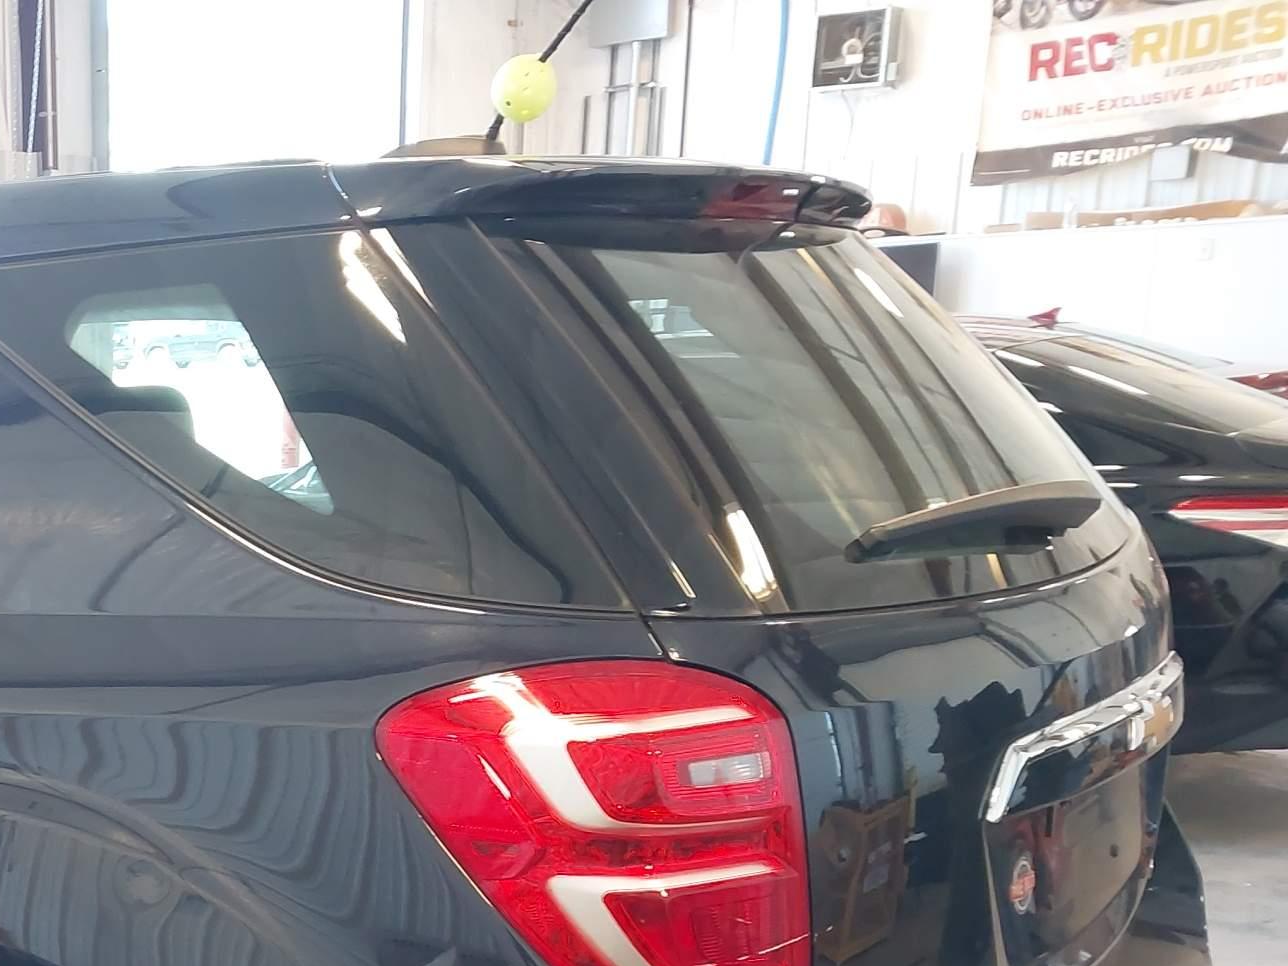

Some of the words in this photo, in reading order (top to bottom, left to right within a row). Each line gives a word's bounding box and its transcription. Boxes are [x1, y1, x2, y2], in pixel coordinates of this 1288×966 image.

[1028, 32, 1118, 82] REC
[1131, 2, 1287, 67] RIDES
[1021, 86, 1194, 121] ONLINE-EXCLUSIVE
